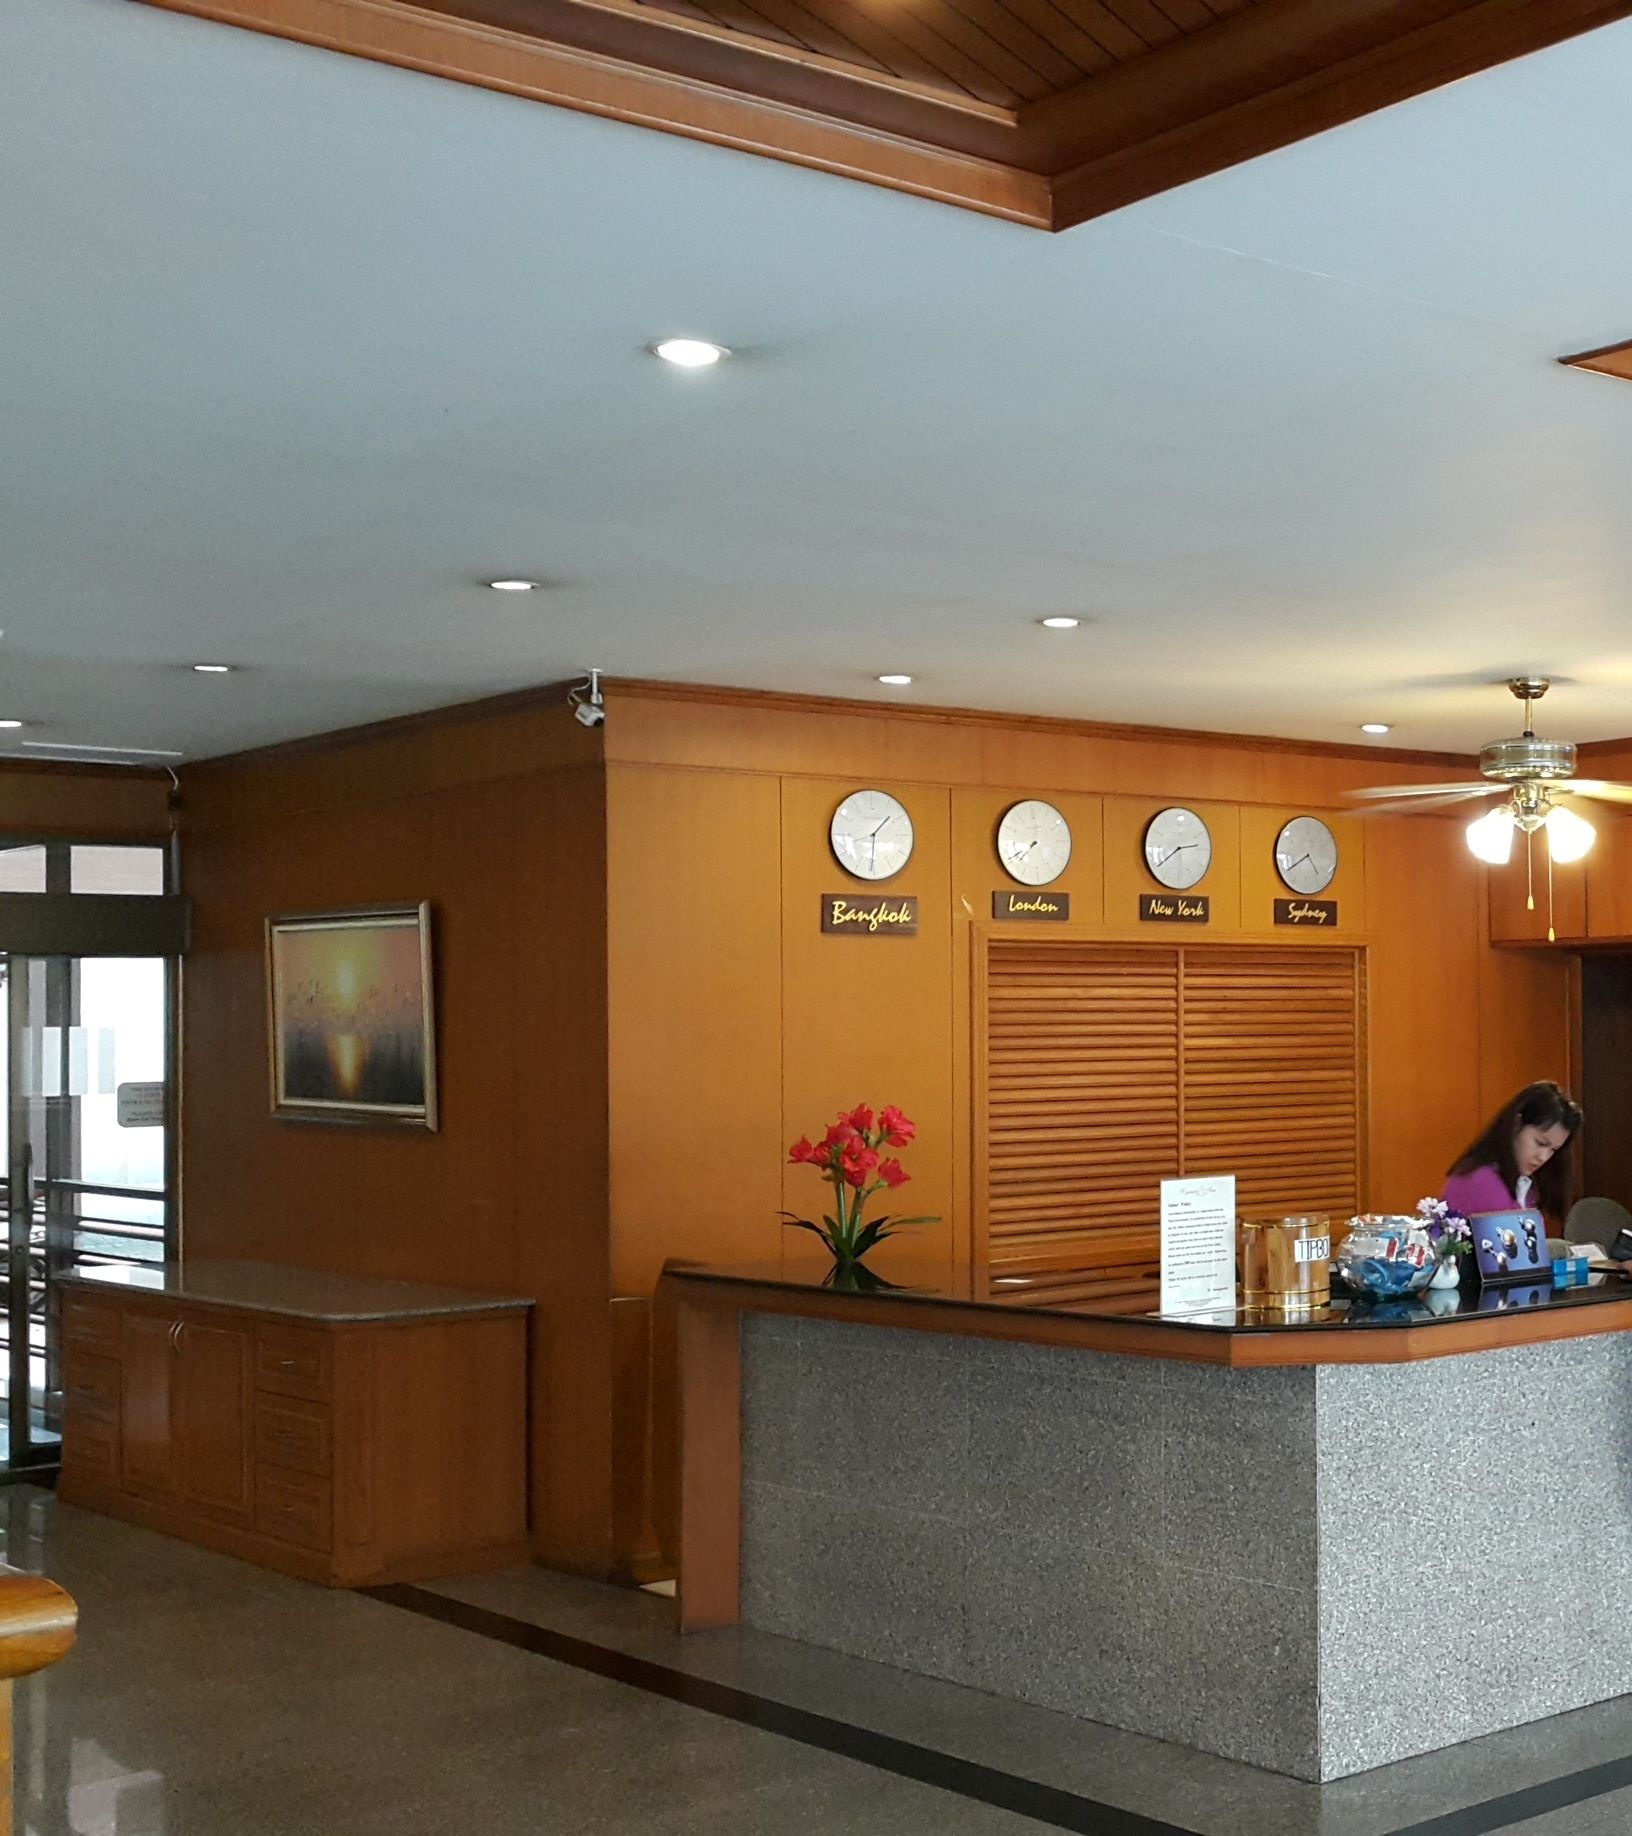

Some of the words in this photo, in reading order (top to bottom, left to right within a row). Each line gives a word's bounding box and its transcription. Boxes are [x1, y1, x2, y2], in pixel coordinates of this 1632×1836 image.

[1008, 894, 1060, 912] London
[1149, 899, 1174, 915] New
[1177, 899, 1205, 917] York
[1287, 902, 1328, 924] Sydney
[832, 901, 912, 931] Bangkok
